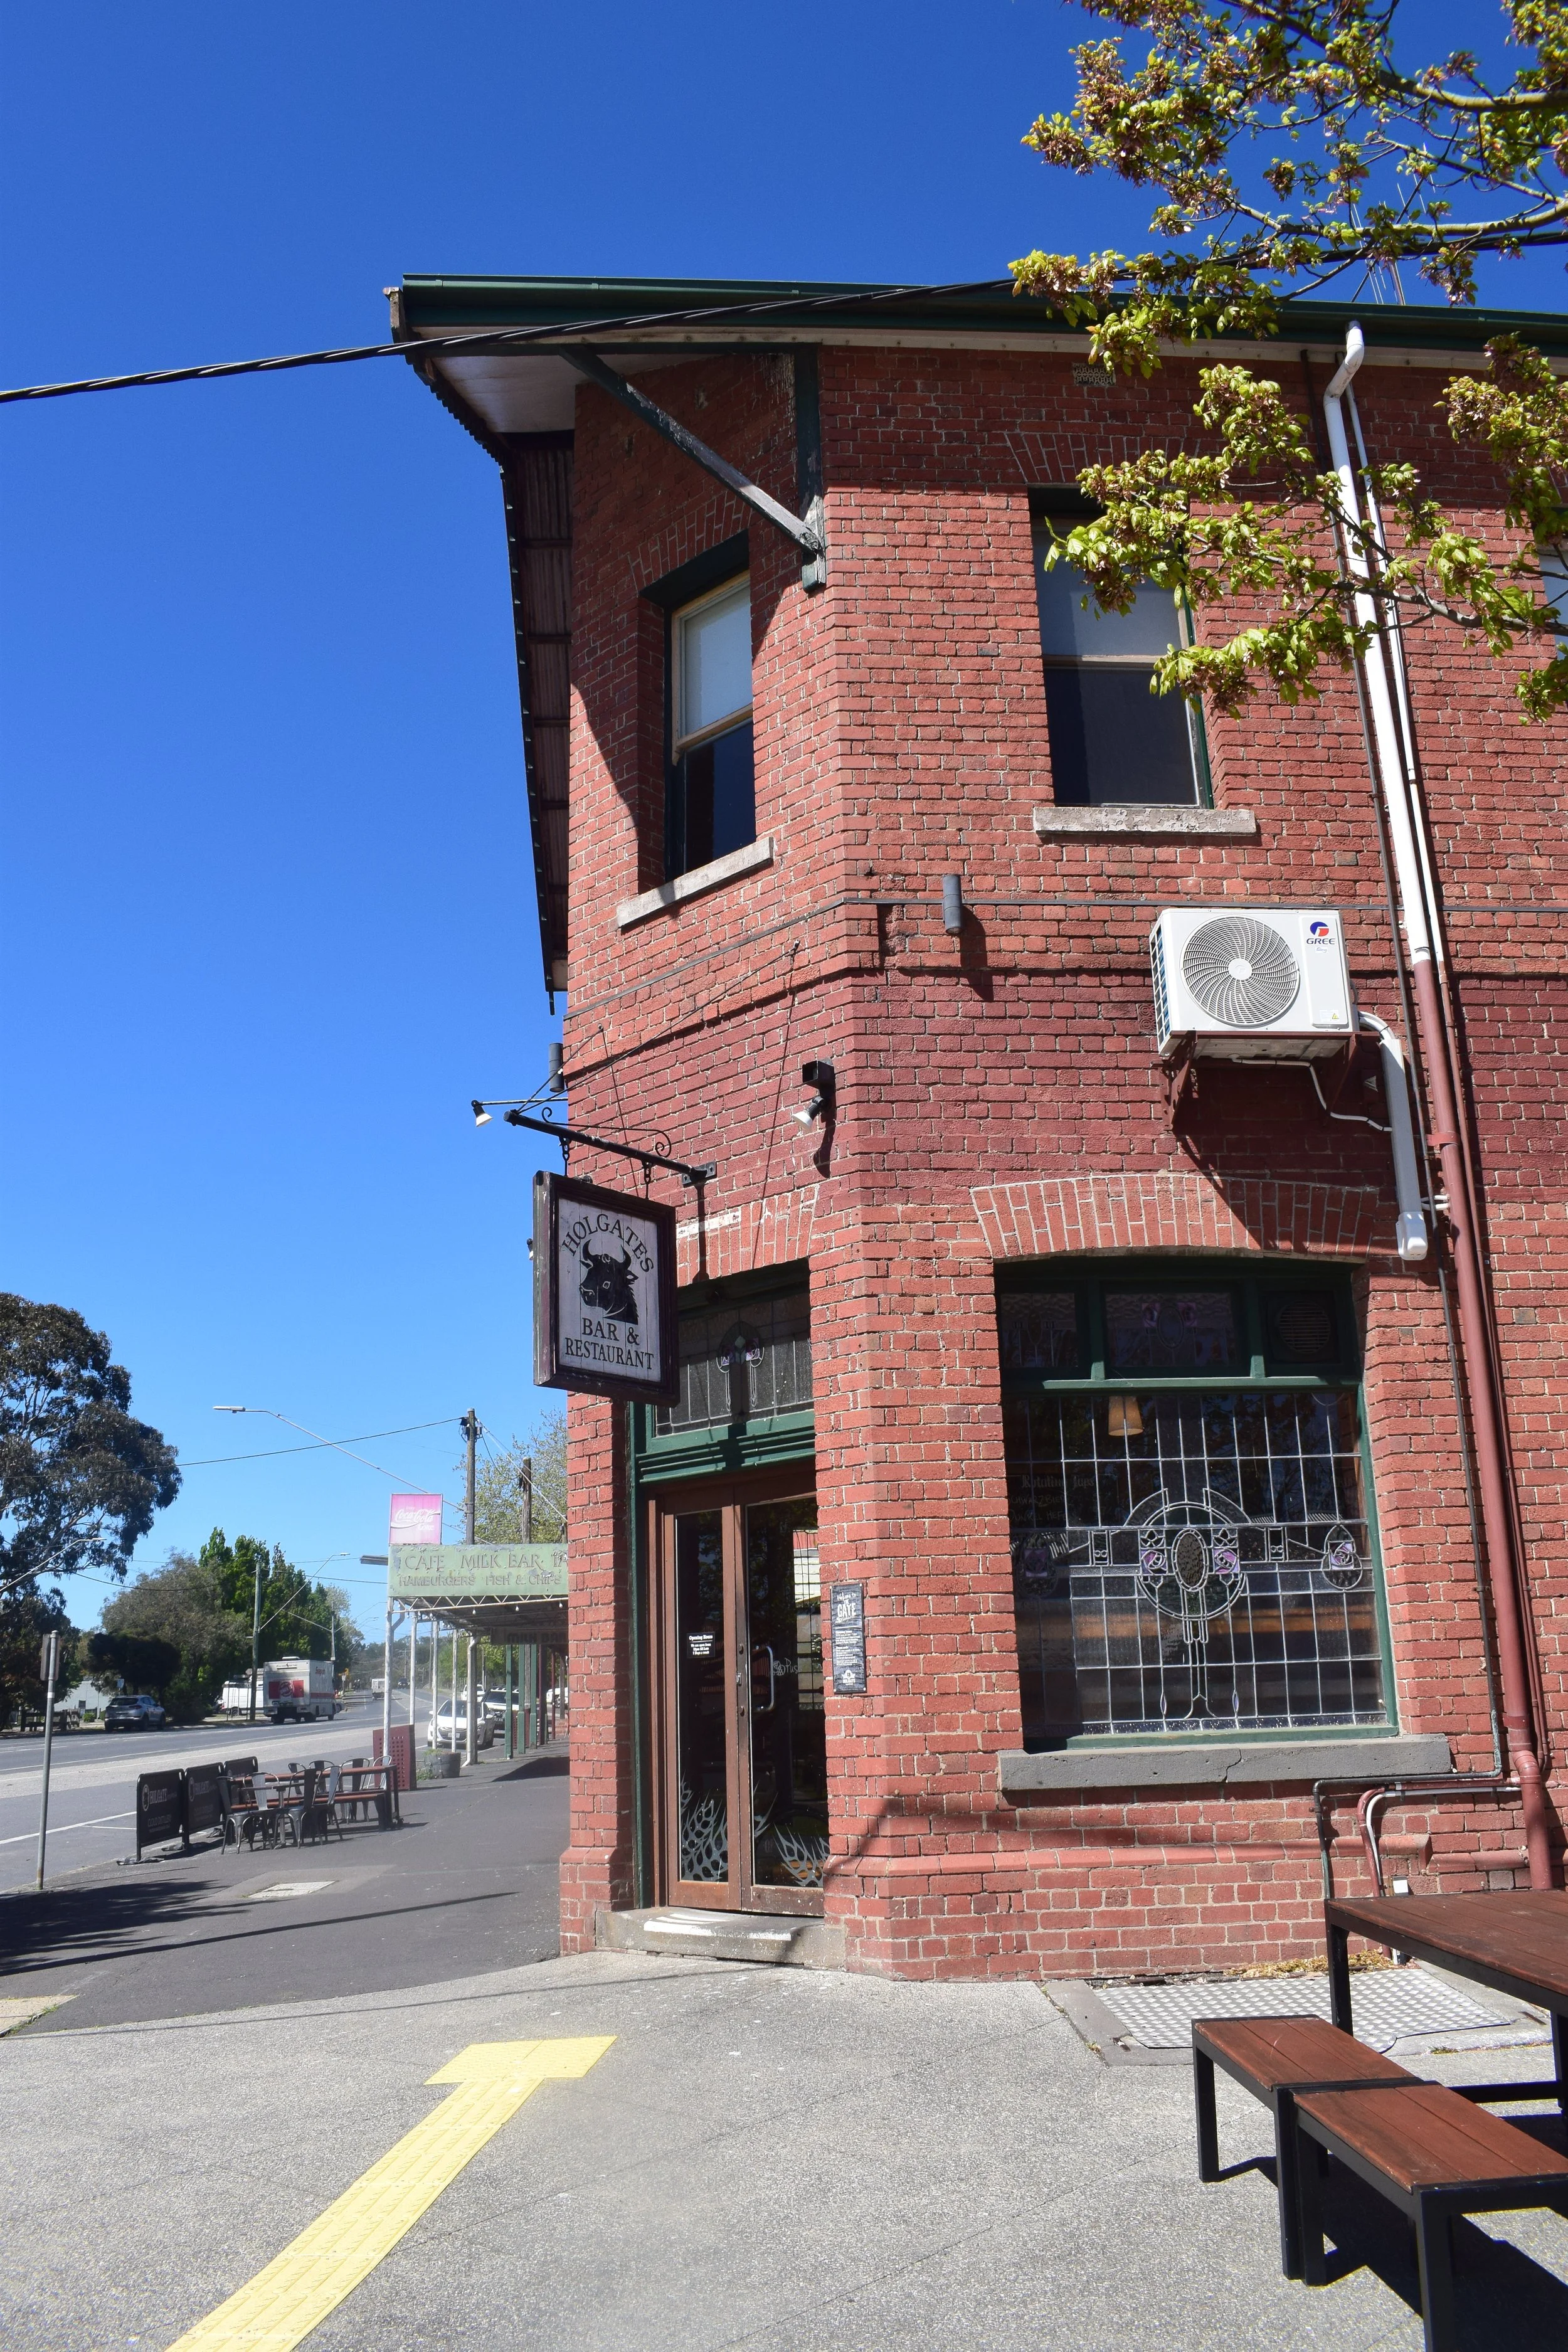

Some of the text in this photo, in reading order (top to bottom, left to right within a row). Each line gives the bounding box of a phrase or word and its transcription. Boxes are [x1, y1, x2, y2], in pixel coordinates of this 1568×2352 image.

[562, 1213, 654, 1273] HOLGATES
[581, 1317, 640, 1346] BAR &
[564, 1337, 654, 1370] RESTAURANT
[395, 1508, 435, 1523] Coca-Cola
[405, 1555, 445, 1569] CAFE
[460, 1554, 502, 1569] MILK
[508, 1554, 544, 1571] BAR
[399, 1574, 562, 1586] HAMBURGERS FISH & CHIPS
[837, 1602, 857, 1618] GATE
